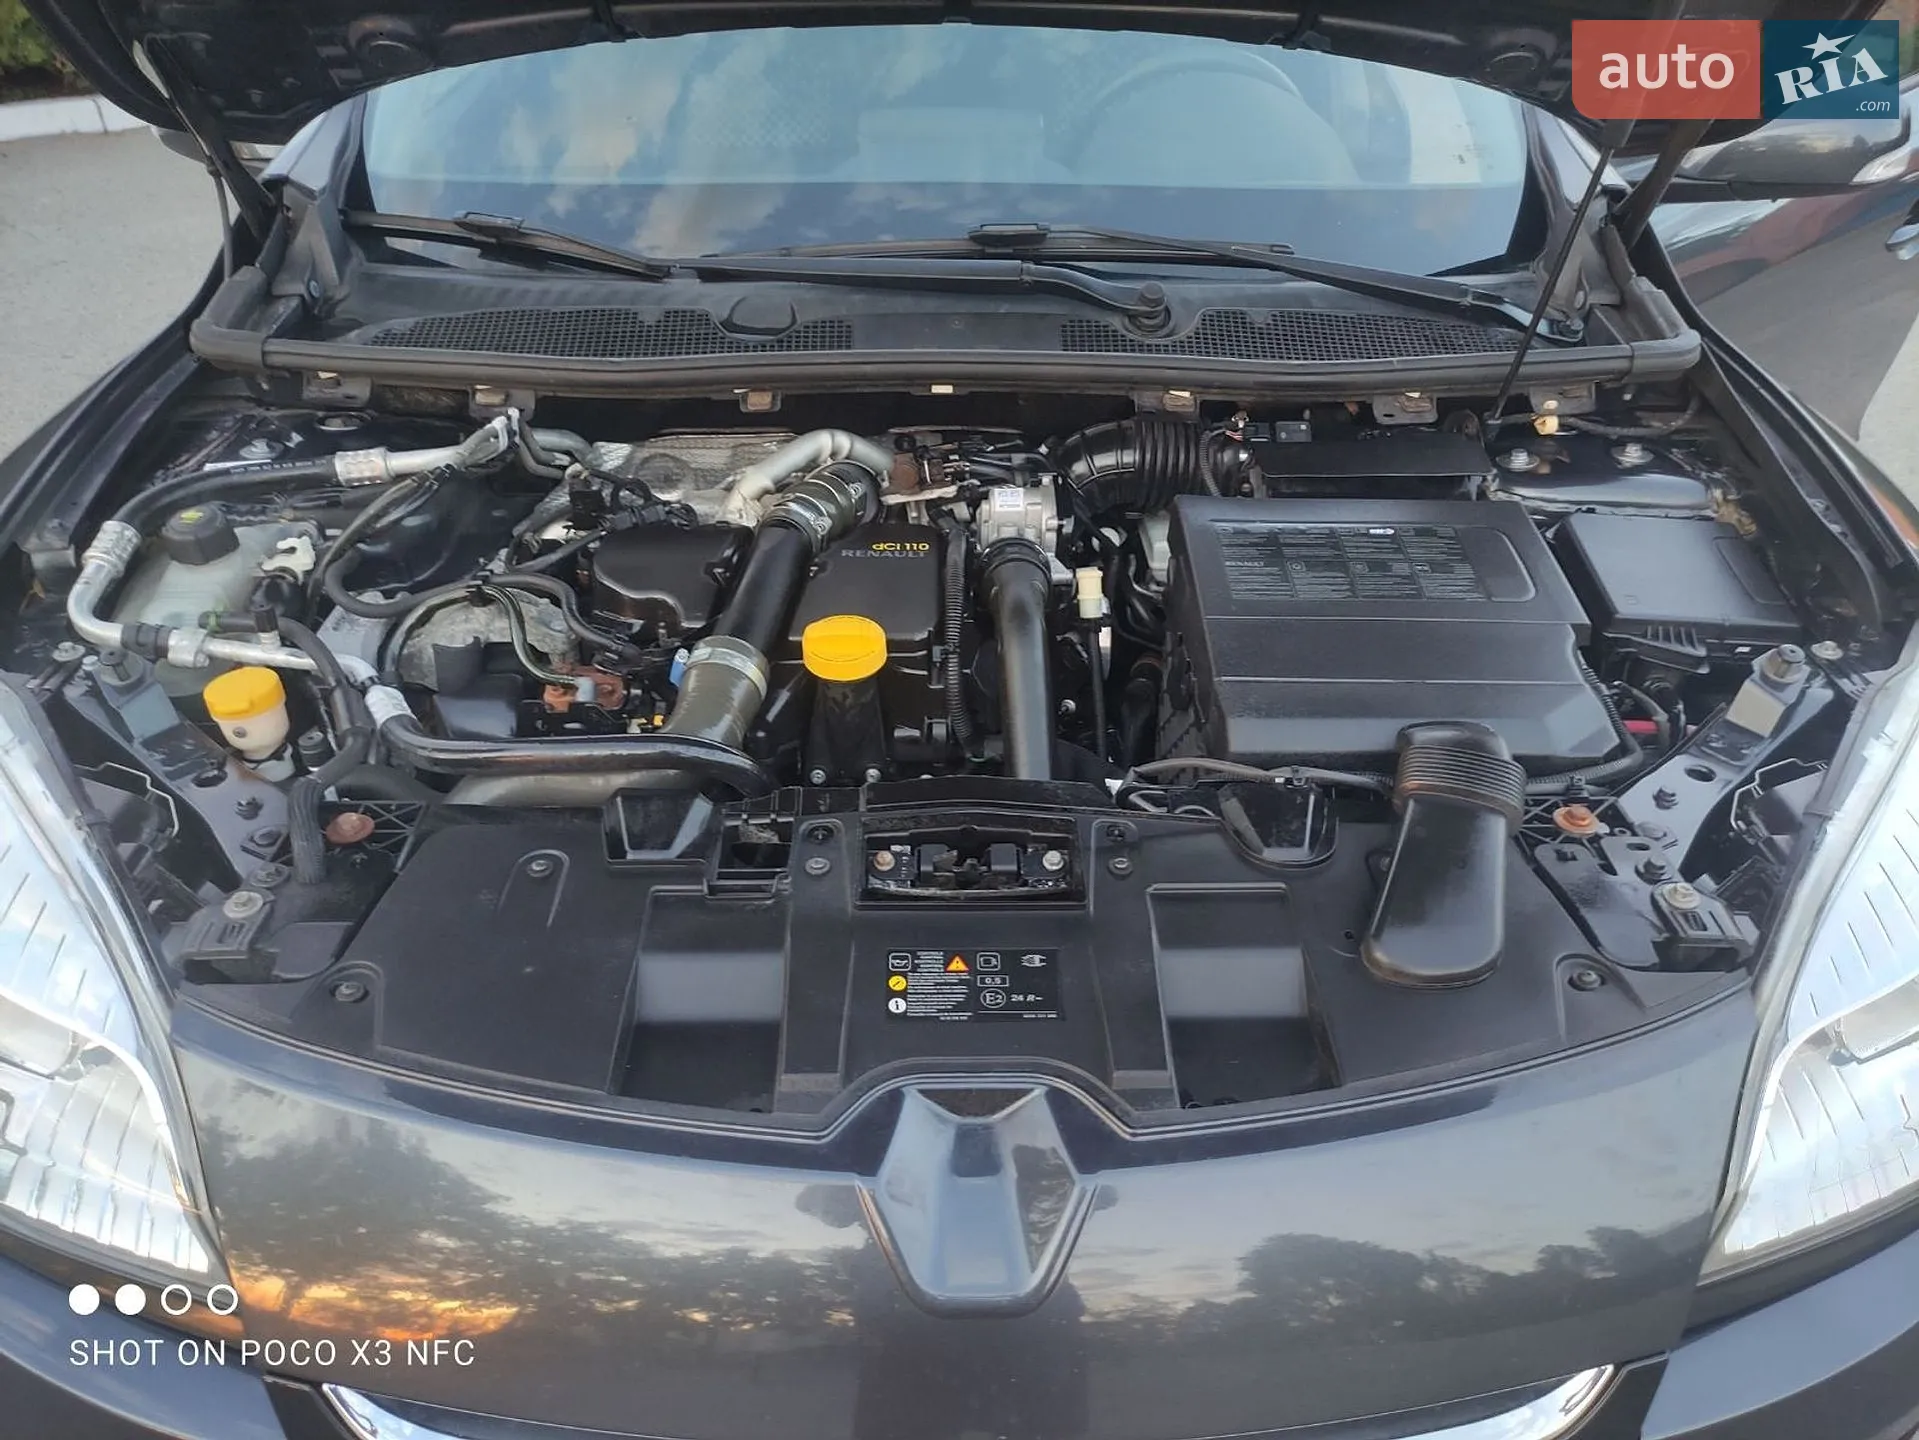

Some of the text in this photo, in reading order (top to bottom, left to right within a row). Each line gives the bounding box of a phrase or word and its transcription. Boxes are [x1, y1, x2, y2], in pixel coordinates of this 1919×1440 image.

[904, 542, 930, 551] 110
[841, 549, 925, 557] RENAULT
[985, 993, 1003, 1004] E2
